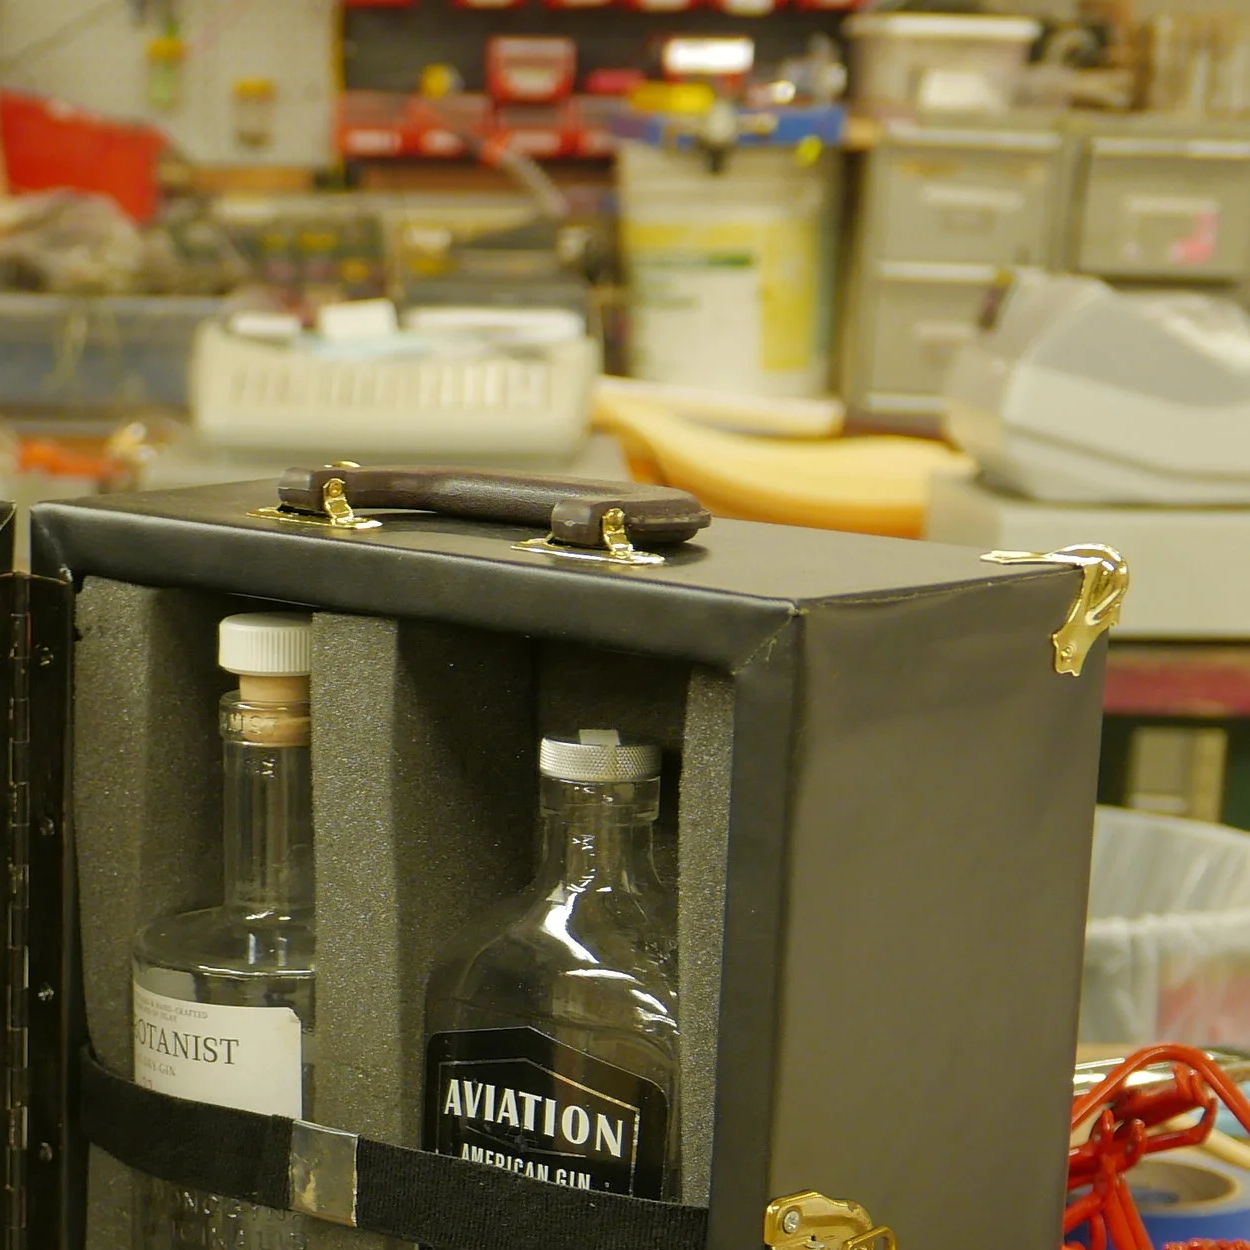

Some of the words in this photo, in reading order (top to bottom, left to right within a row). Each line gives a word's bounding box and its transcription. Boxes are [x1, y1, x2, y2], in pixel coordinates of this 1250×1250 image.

[159, 1063, 176, 1077] GIN
[444, 1078, 624, 1158] AVIATION
[556, 1168, 592, 1191] GIN
